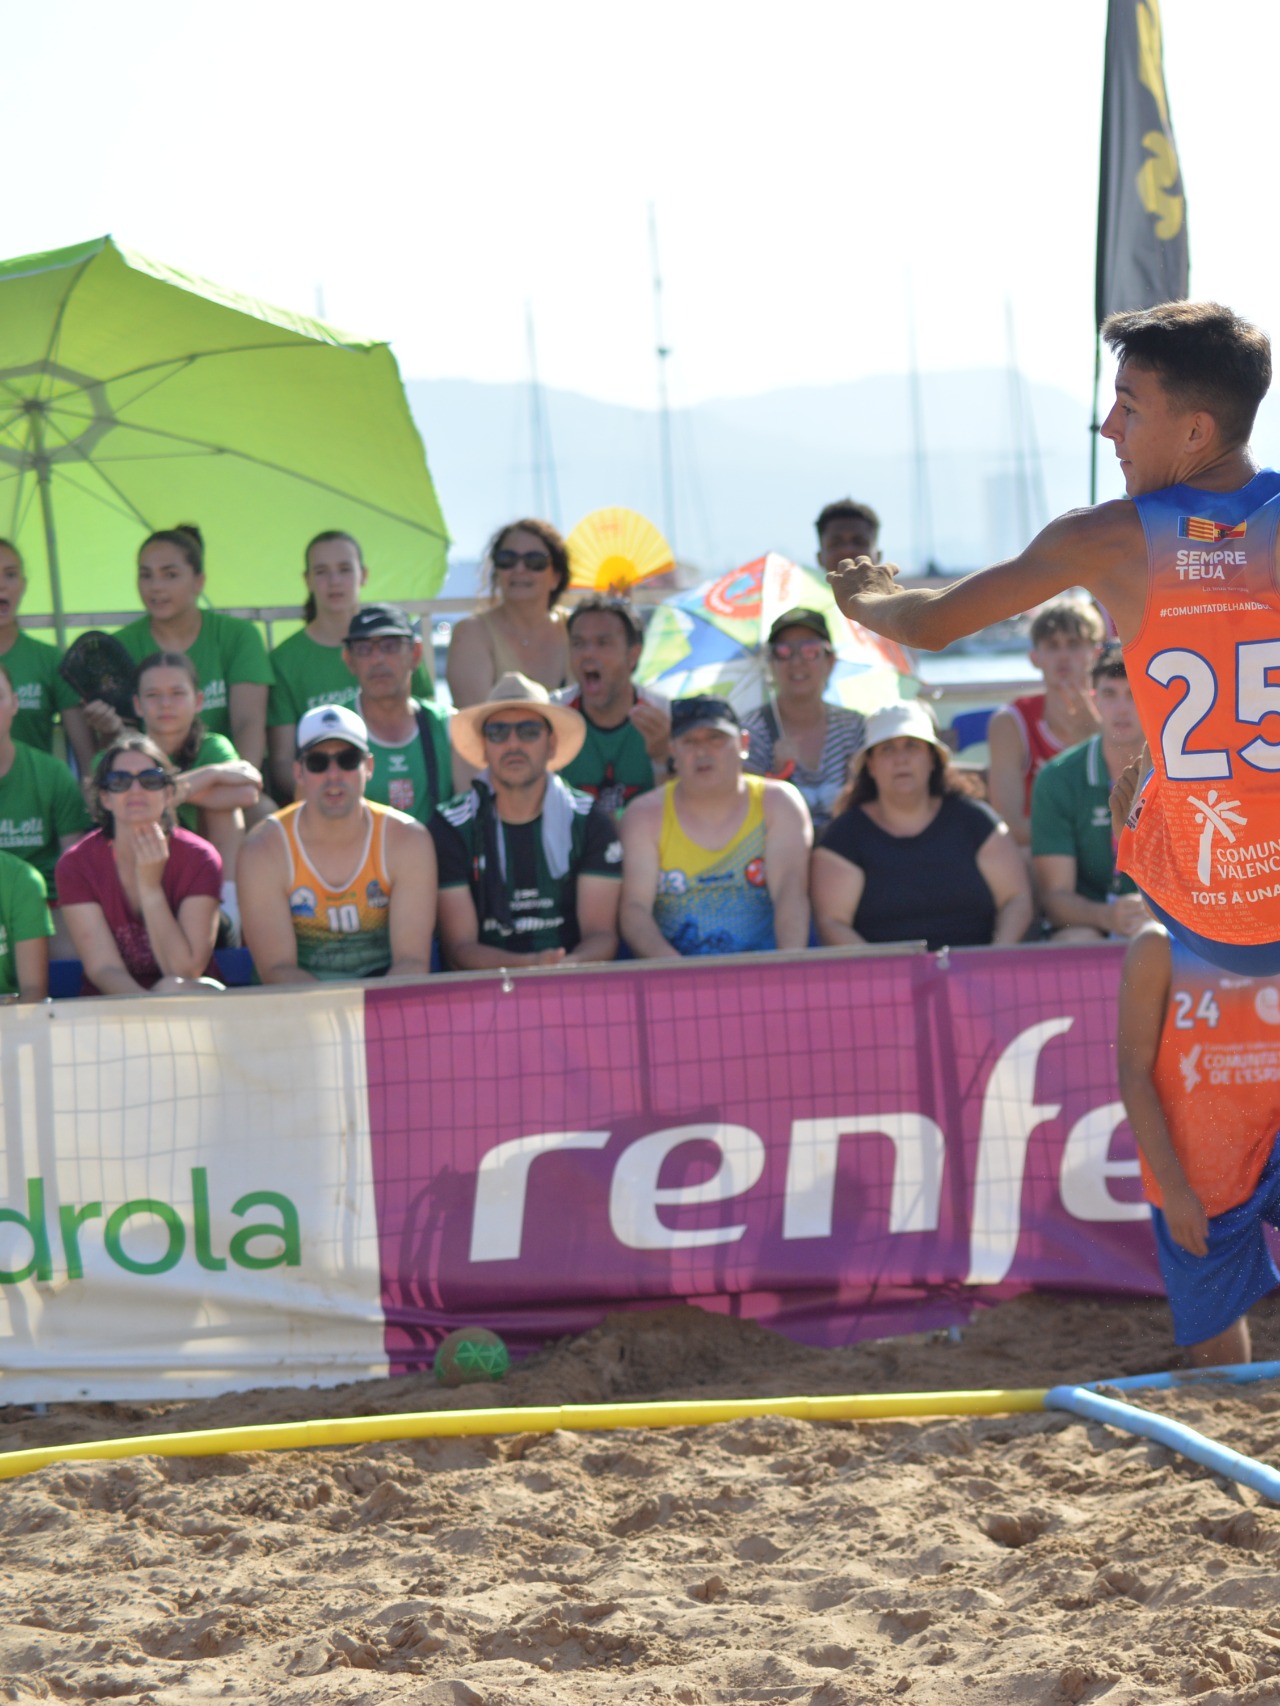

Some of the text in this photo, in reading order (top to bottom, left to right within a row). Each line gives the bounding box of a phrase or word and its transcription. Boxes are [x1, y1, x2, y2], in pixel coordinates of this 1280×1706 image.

[1176, 549, 1248, 566] SEMPRE
[1175, 565, 1226, 580] TEUA
[1191, 891, 1227, 906] TOTS
[1231, 891, 1244, 904] A
[327, 903, 360, 934] 10
[1174, 989, 1221, 1030] 24
